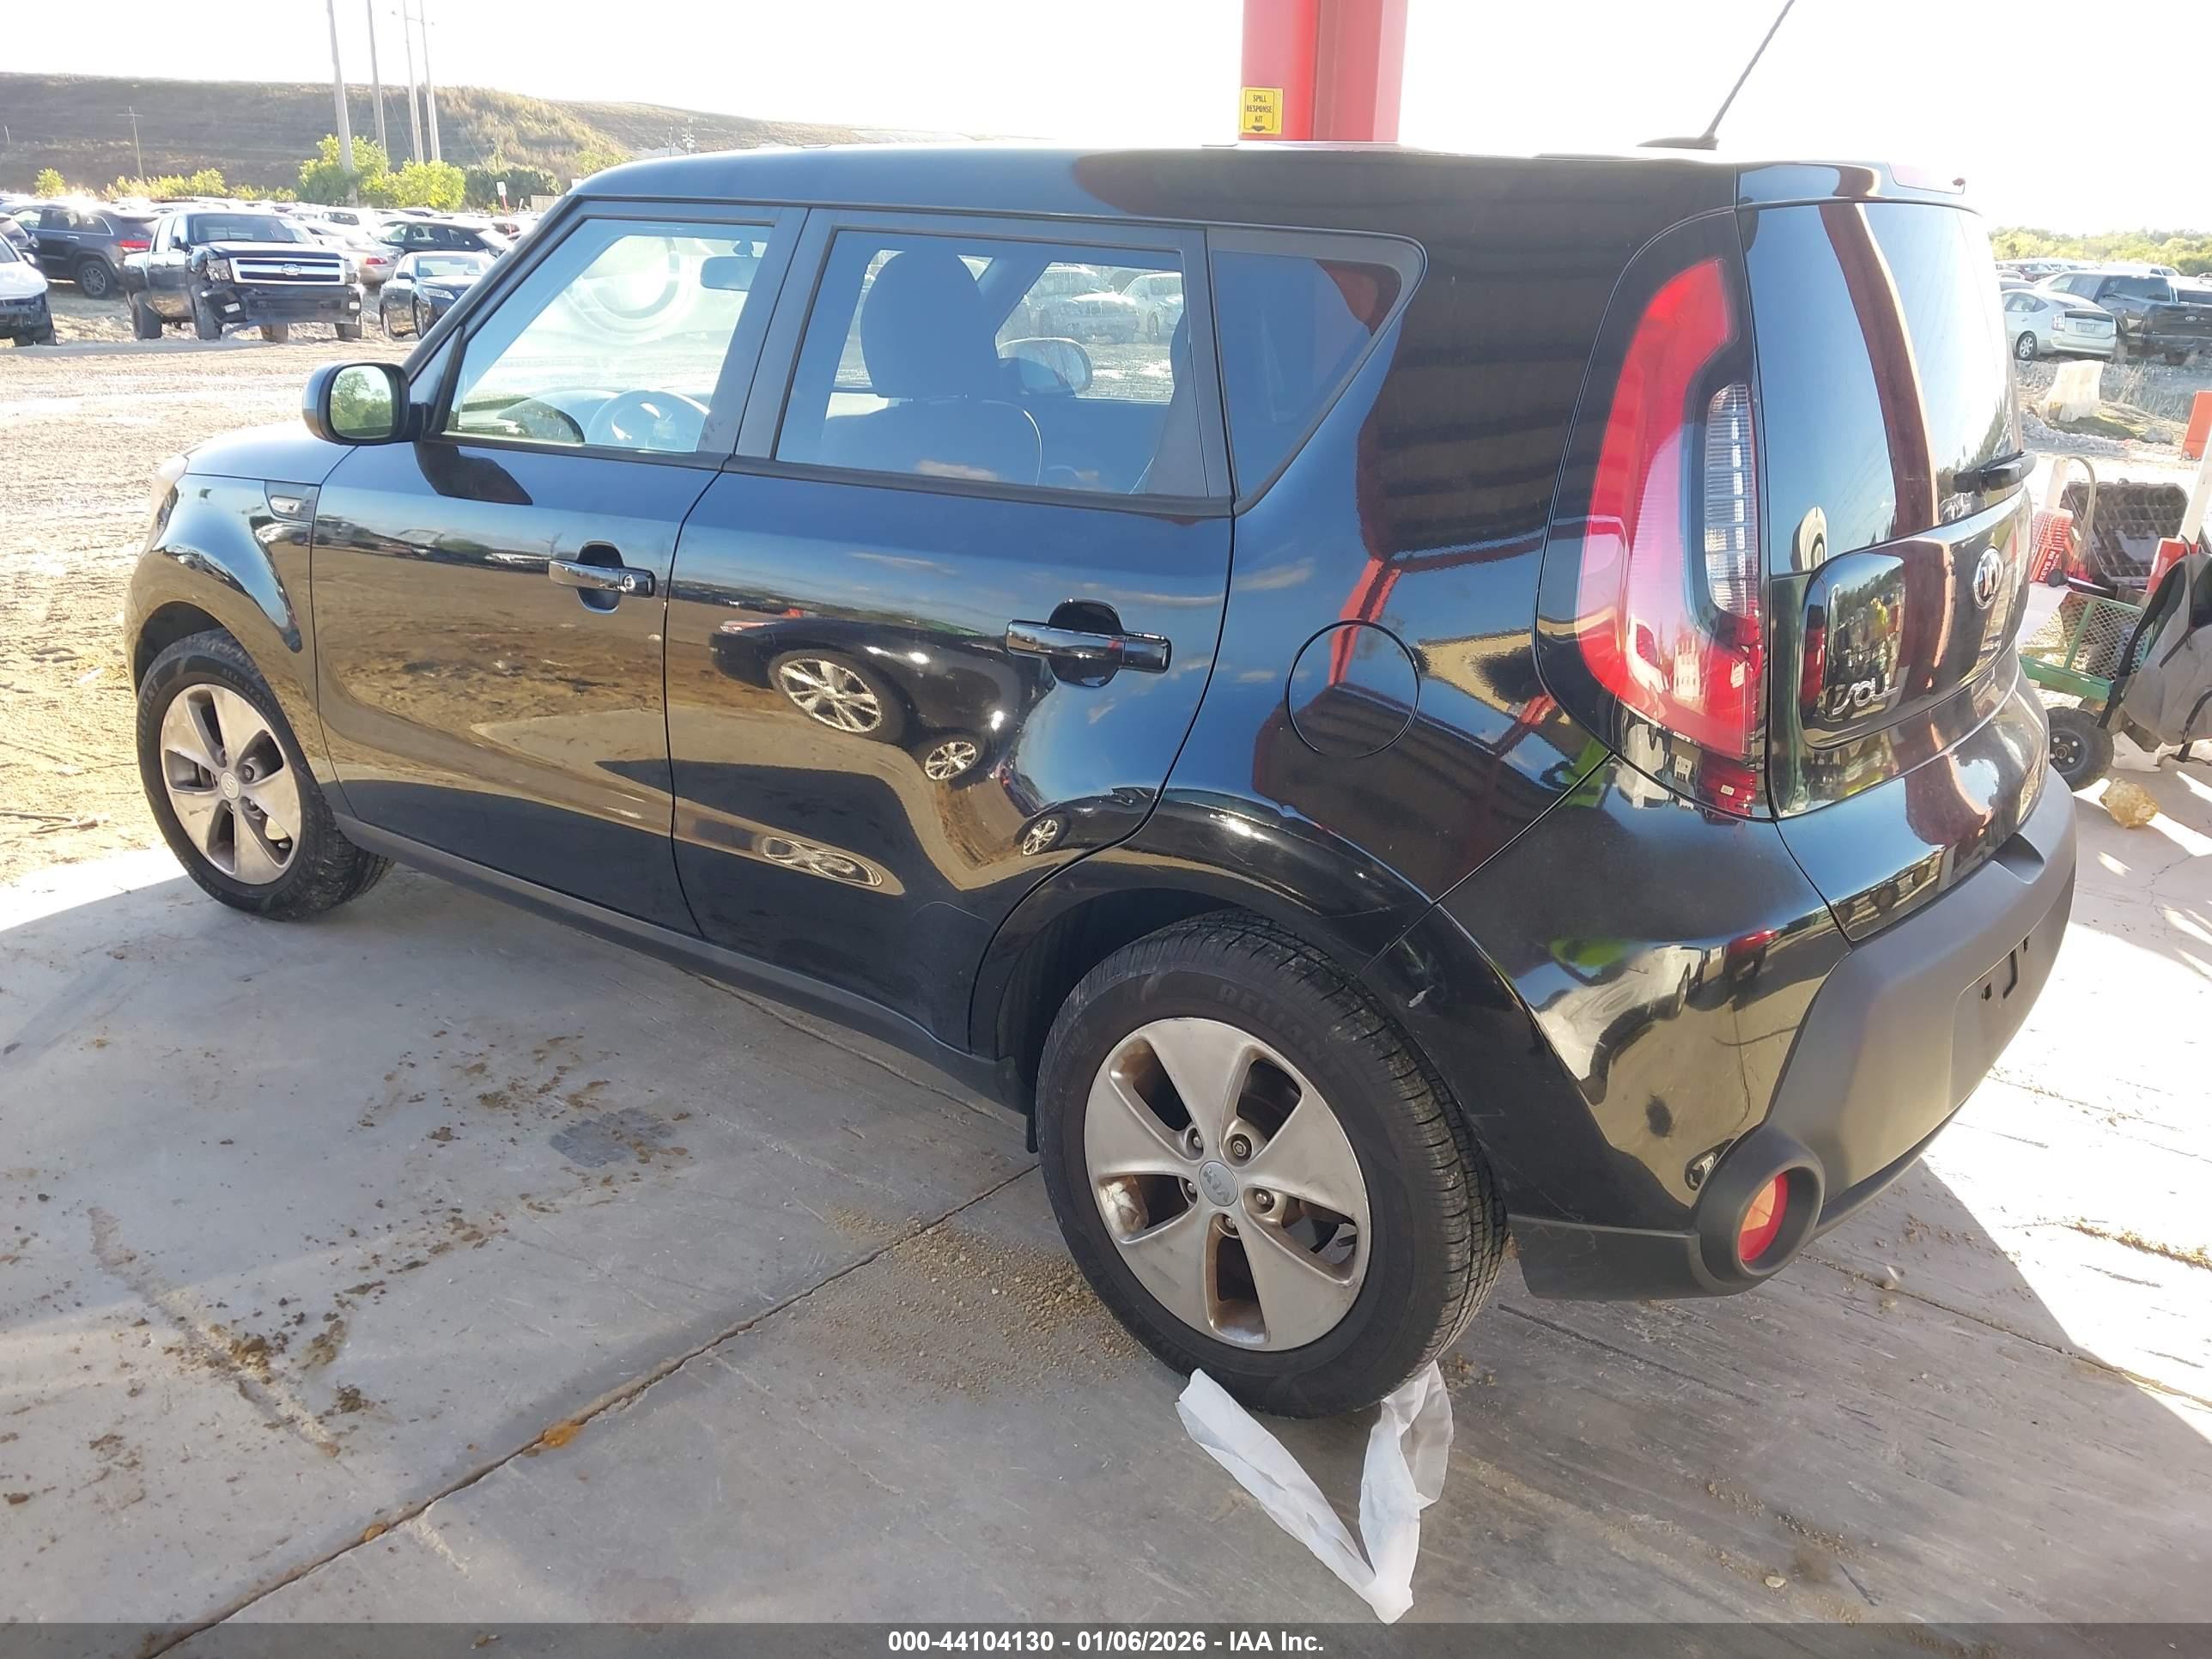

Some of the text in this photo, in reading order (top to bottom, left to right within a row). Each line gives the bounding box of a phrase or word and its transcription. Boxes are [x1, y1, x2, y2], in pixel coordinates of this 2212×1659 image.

[1253, 94, 1267, 103] SPILL
[1246, 105, 1273, 113] RESPONSE
[2038, 550, 2057, 581] KEYS IN
